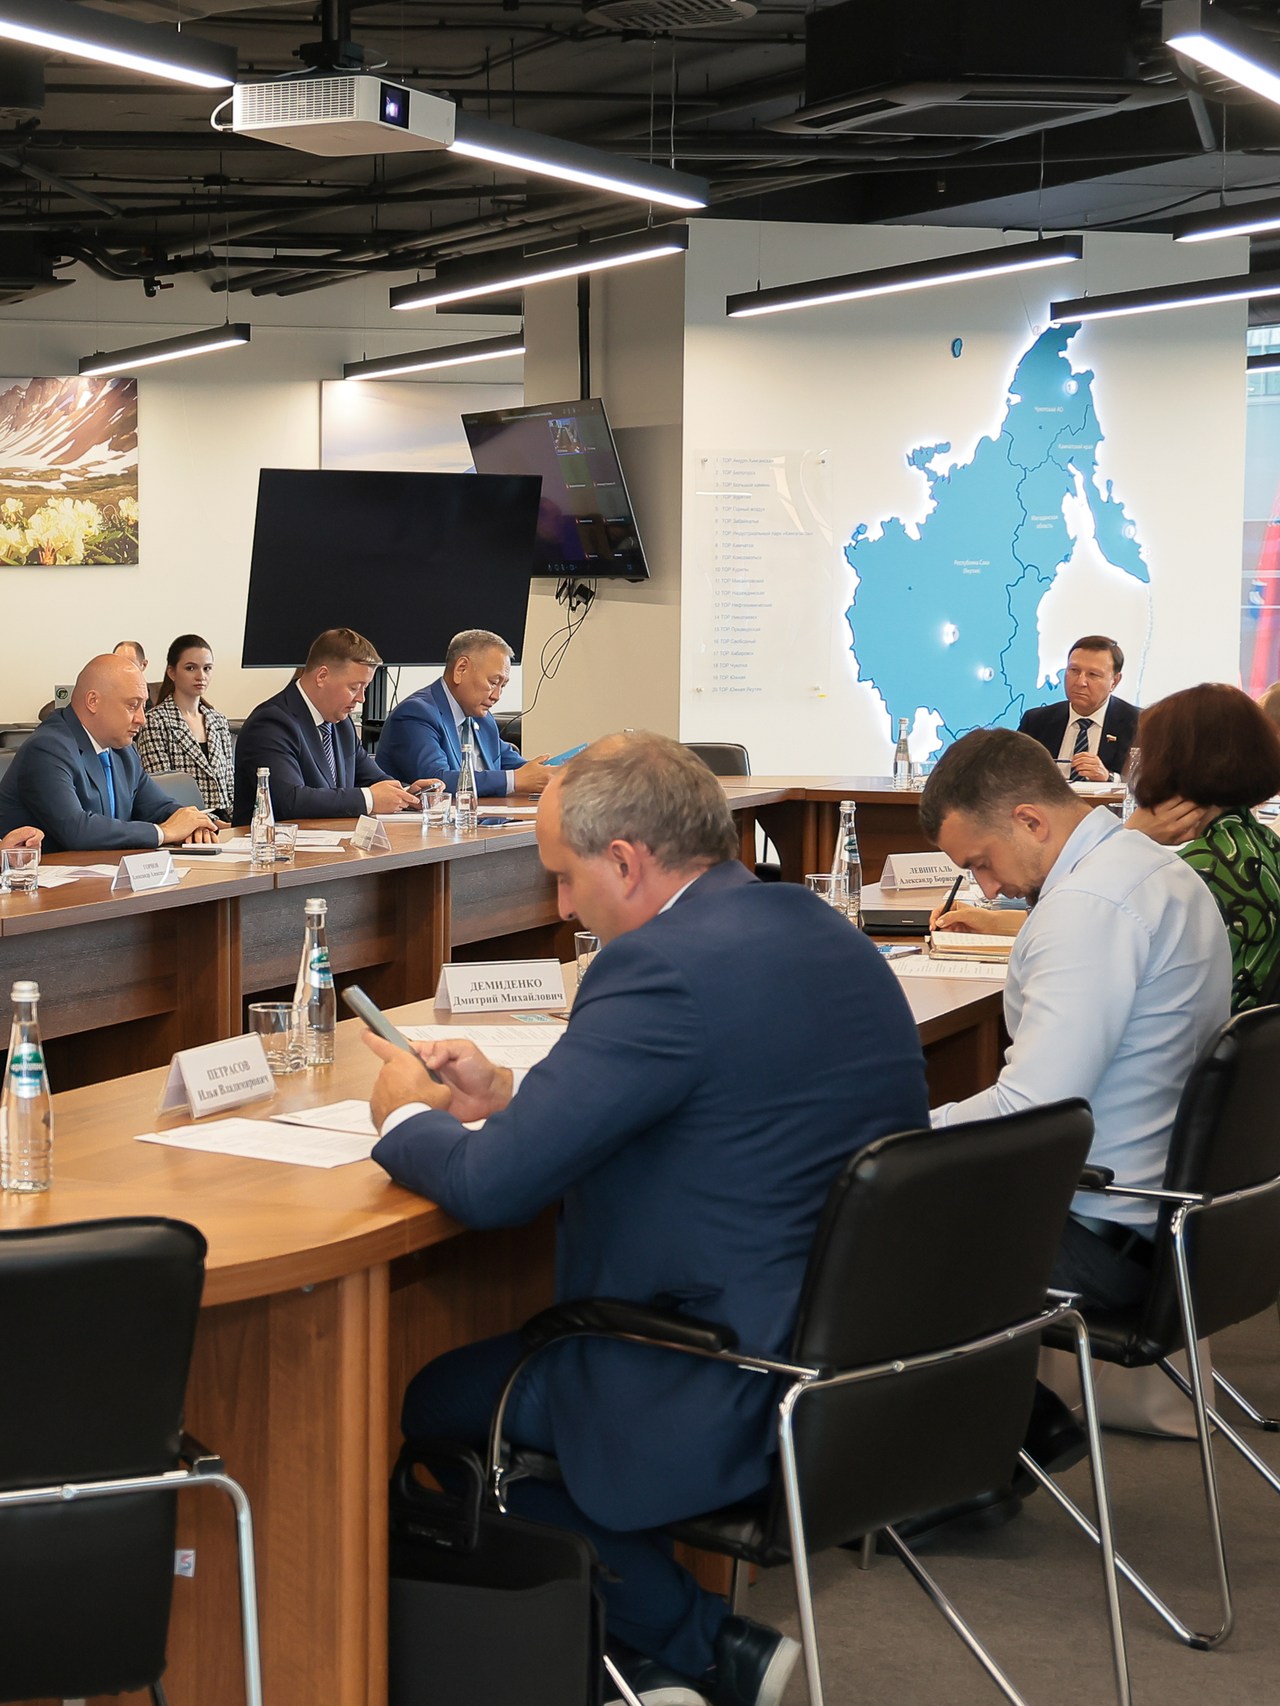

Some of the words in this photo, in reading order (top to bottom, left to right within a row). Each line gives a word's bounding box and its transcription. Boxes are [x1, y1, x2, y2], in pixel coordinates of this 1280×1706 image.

[909, 865, 953, 875] ЛЕВИНТАЛЬ
[900, 877, 933, 885] Александр
[470, 978, 542, 992] ДЕМИДЕНКО
[453, 994, 499, 1007] Дмитрий
[501, 992, 563, 1003] Михайлович
[206, 1060, 251, 1081] ПЕТРАСОВ
[197, 1088, 219, 1102] Илья
[218, 1075, 270, 1097] Владимирович
